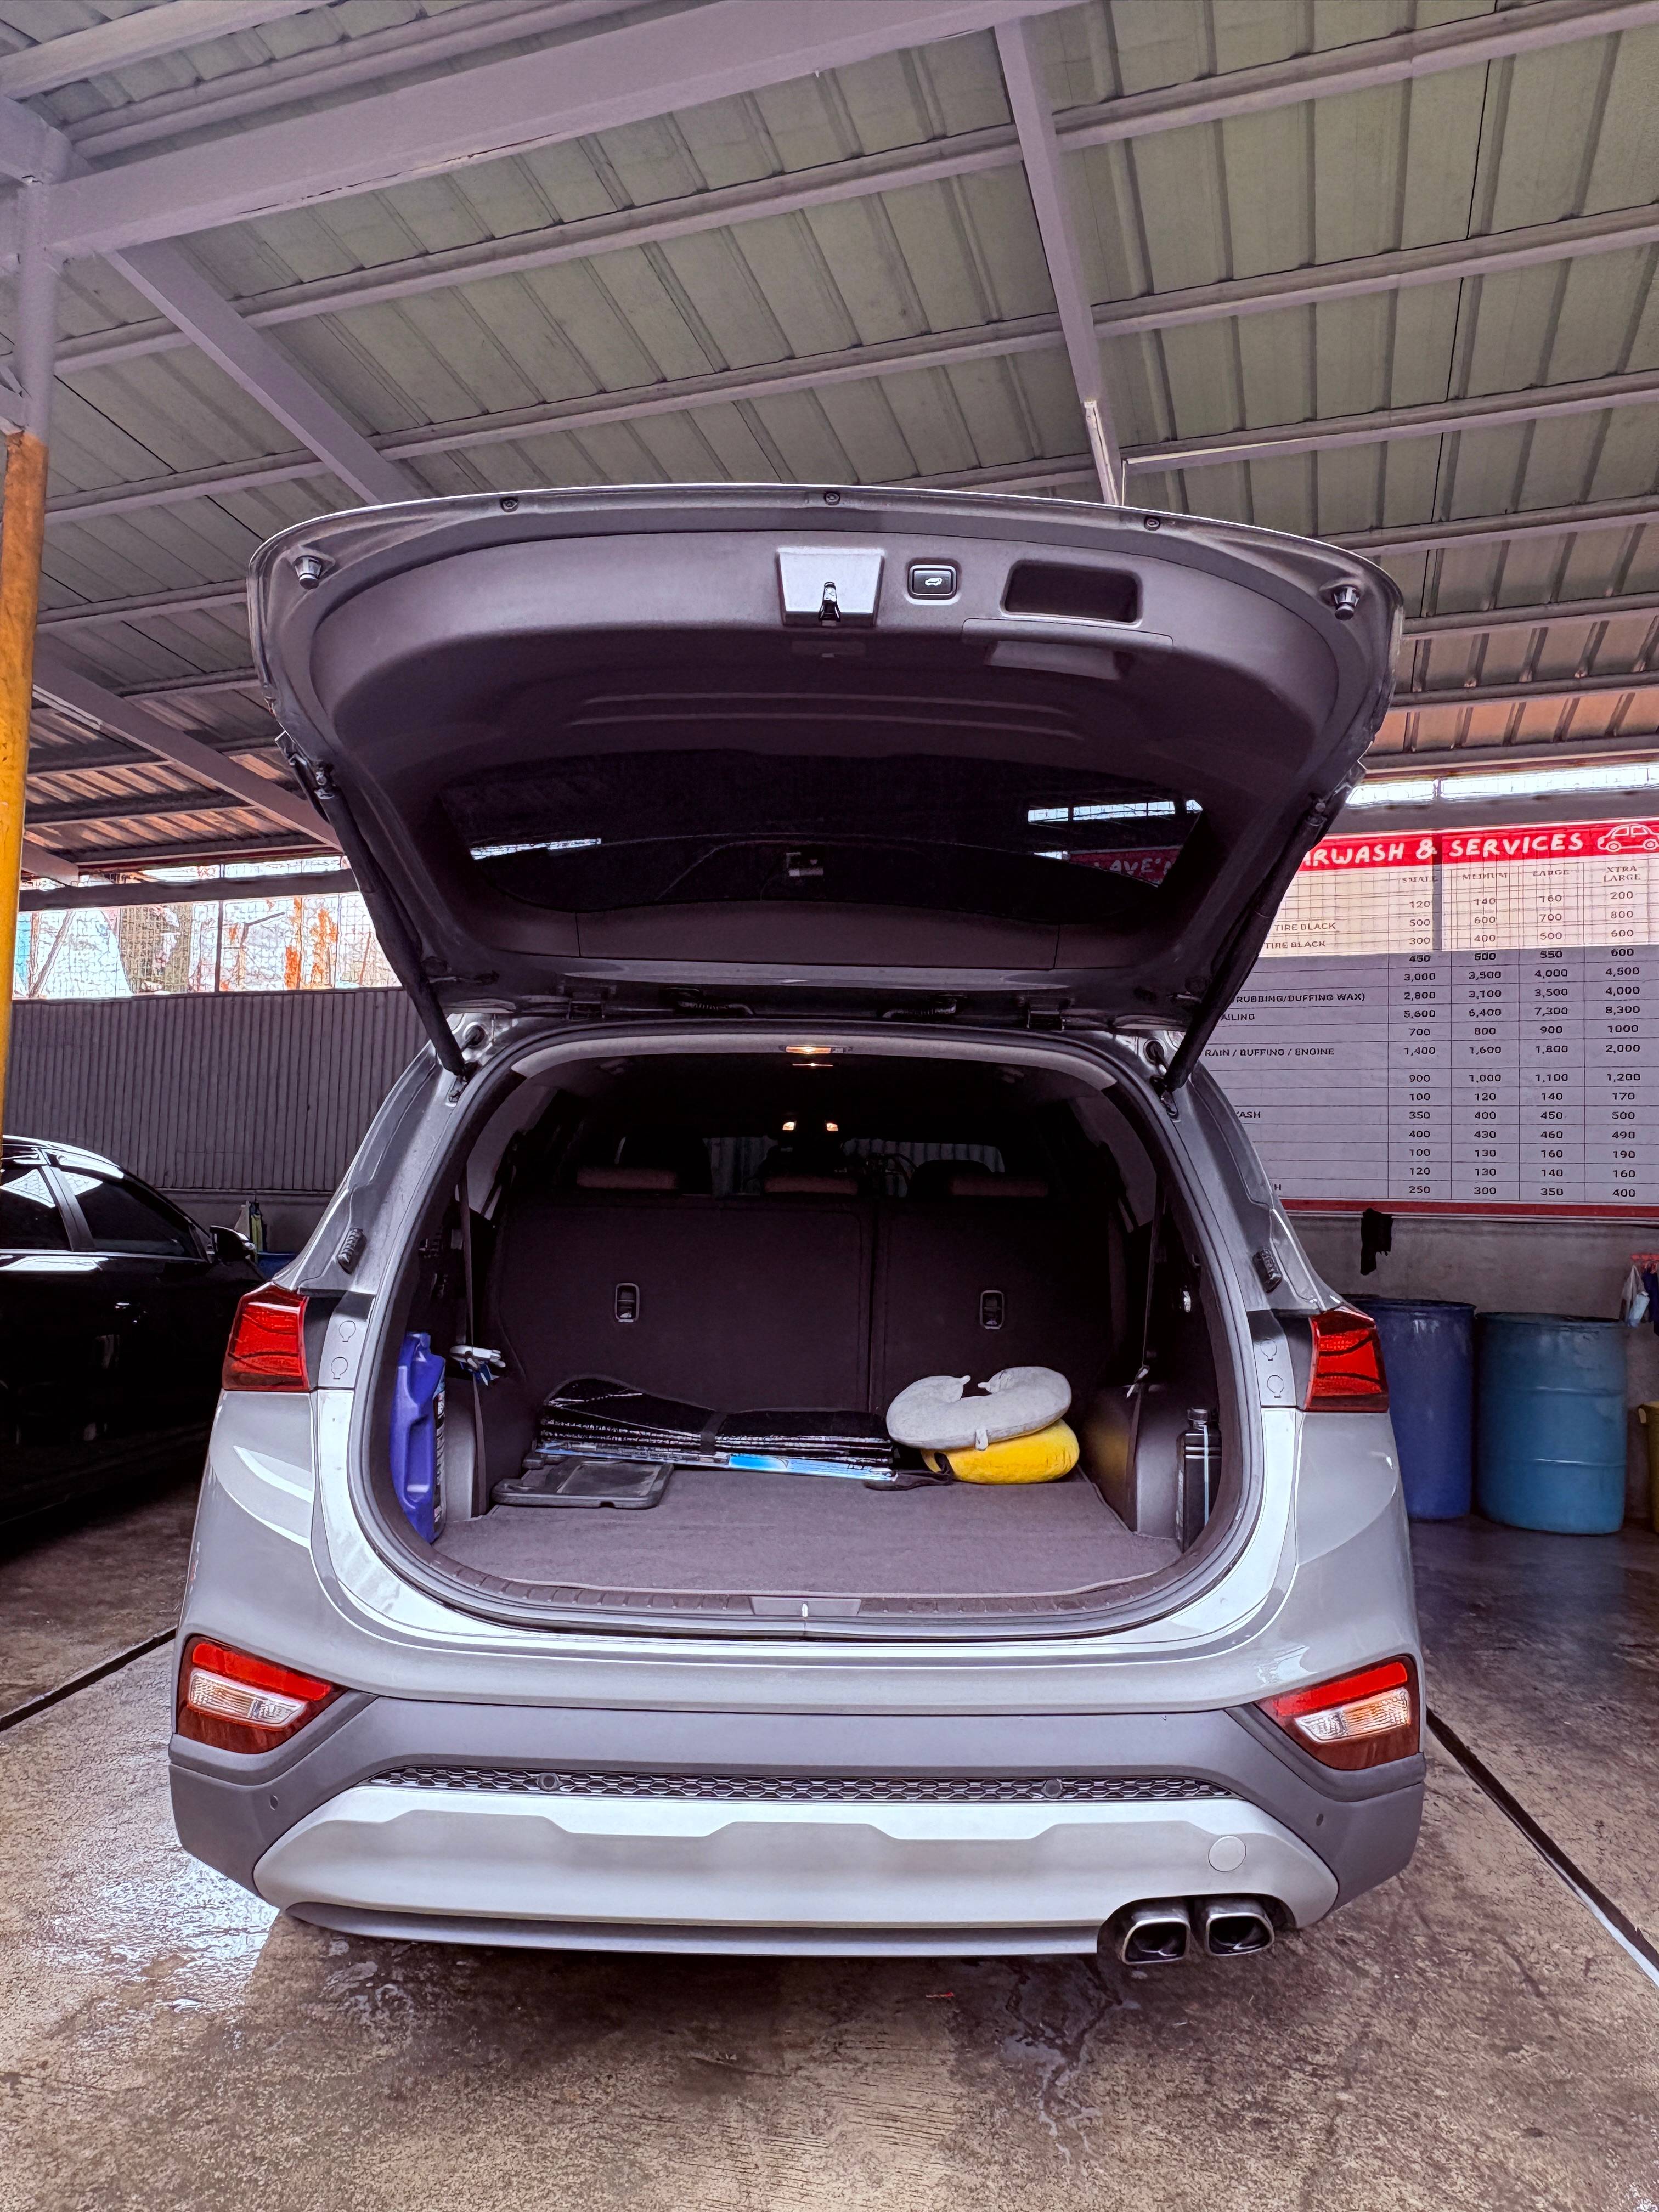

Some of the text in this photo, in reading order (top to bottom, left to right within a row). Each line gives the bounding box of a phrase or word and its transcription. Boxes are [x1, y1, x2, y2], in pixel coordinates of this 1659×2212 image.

[1302, 832, 1583, 867] ARWASH & SERVICES
[1603, 873, 1641, 882] LARGE
[1539, 913, 1562, 922] 700
[1535, 969, 1567, 978] 4,000
[1606, 967, 1639, 977] 4,500
[1606, 987, 1640, 996] 4,000
[1469, 1009, 1501, 1018] 6,400
[1404, 1047, 1435, 1056] 1,400
[1606, 1045, 1640, 1054] 2,000
[1536, 1074, 1567, 1082] 1,100
[1607, 1074, 1640, 1082] 1,200
